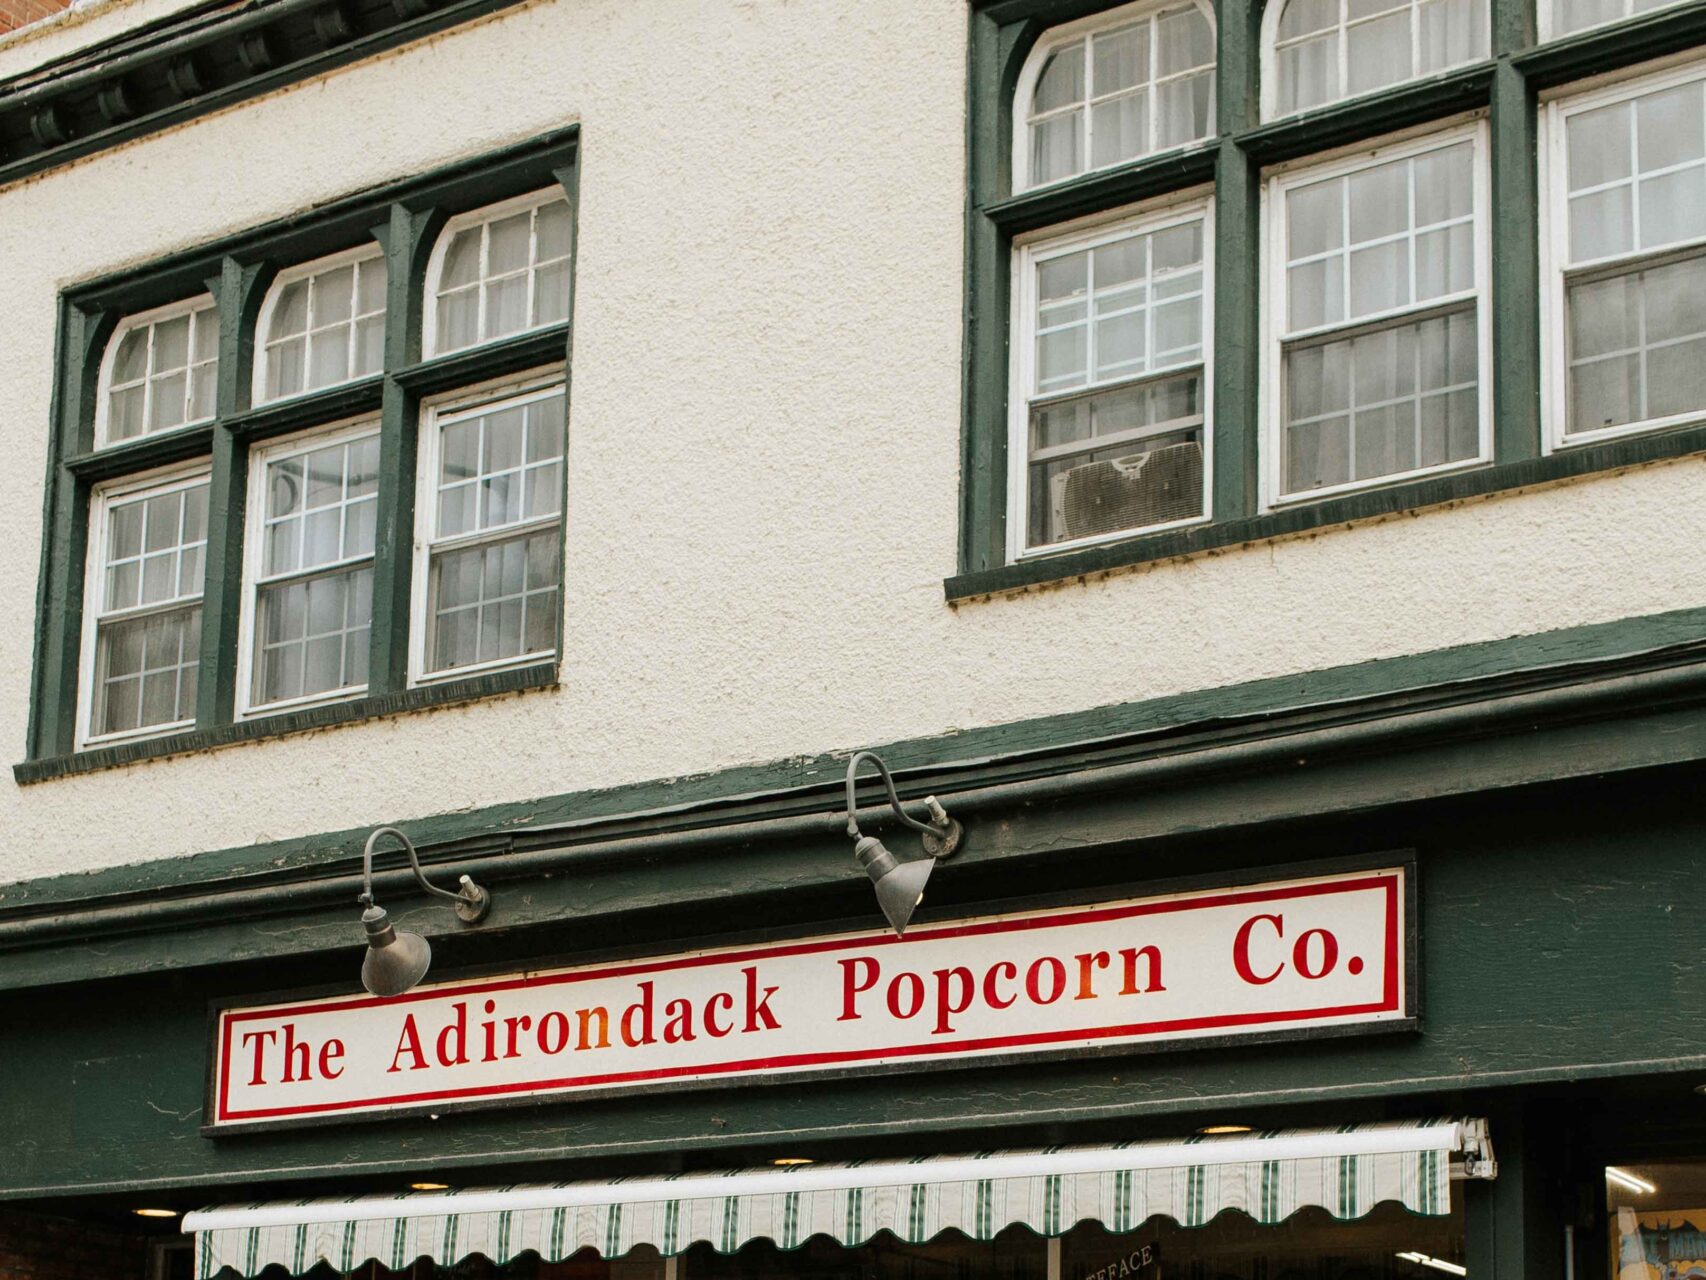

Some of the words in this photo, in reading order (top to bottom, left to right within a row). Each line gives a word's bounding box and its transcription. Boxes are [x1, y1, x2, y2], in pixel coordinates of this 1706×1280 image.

[242, 1024, 345, 1086] The
[386, 966, 783, 1073] Adirondack
[836, 942, 1166, 1034] Popcorn
[1232, 913, 1364, 985] Co.
